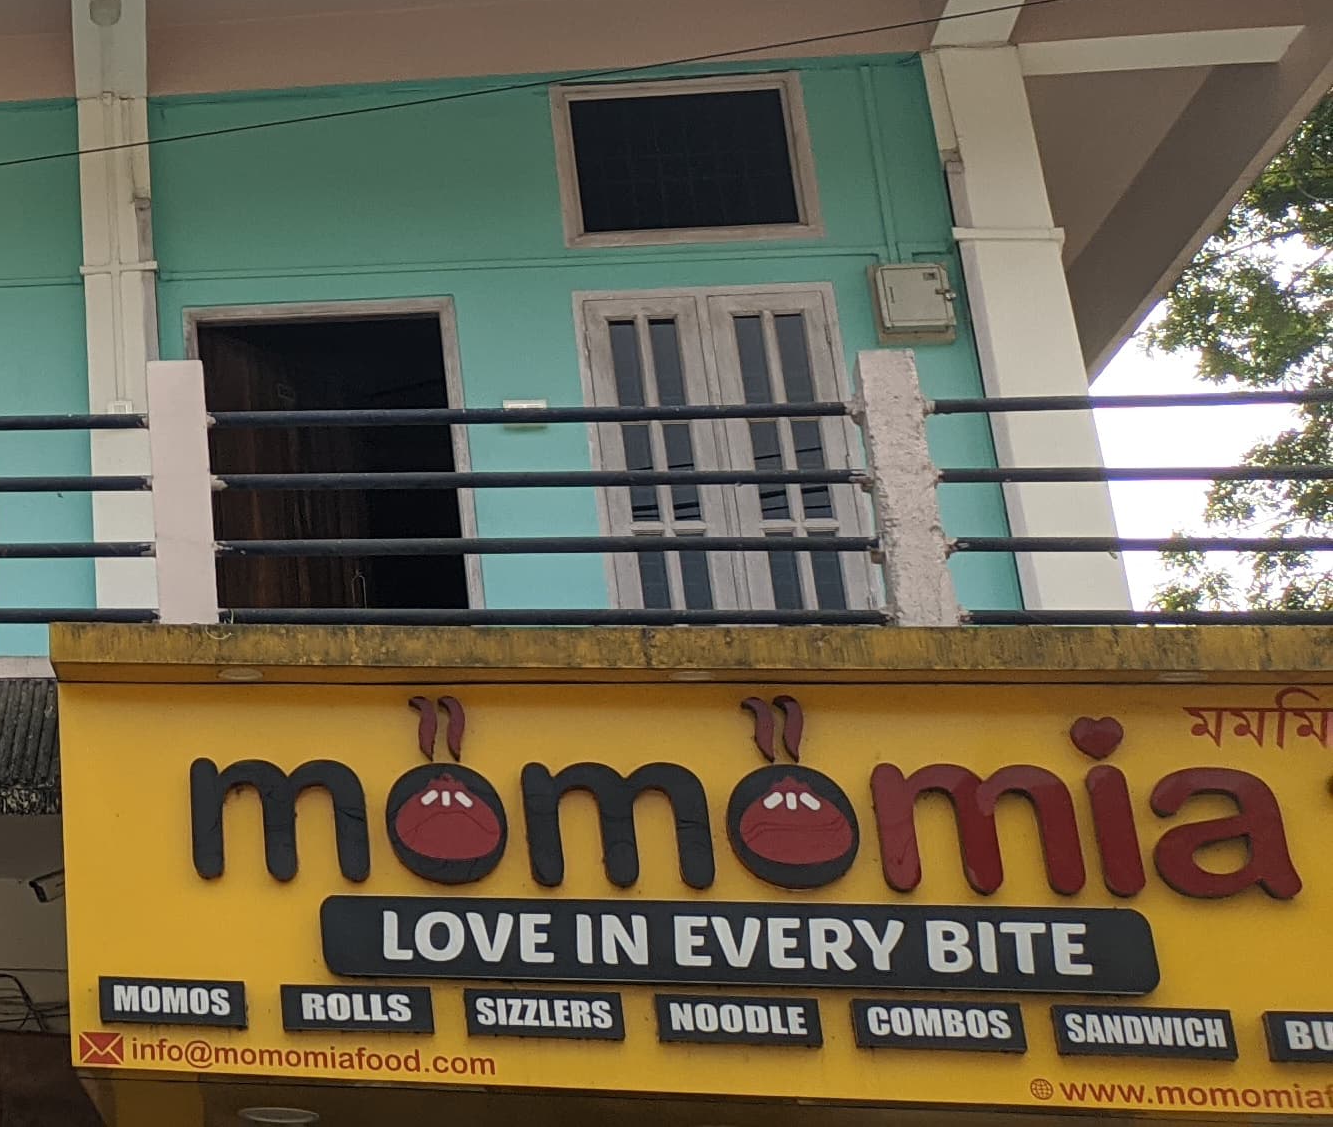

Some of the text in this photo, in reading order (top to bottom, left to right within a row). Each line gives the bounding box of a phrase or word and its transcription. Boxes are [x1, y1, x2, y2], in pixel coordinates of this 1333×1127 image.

[190, 715, 1303, 899] momomia
[382, 910, 1093, 976] LOVE IN EVERY BITE
[113, 985, 231, 1017] MOMOS
[301, 992, 412, 1024] ROLLS
[475, 996, 613, 1030] SIZZLERS
[669, 1002, 808, 1036] NOODLE
[867, 1006, 1012, 1040] COMBOS
[1065, 1013, 1227, 1049] SANDWICH
[131, 1036, 496, 1076] info@momomiafood.com
